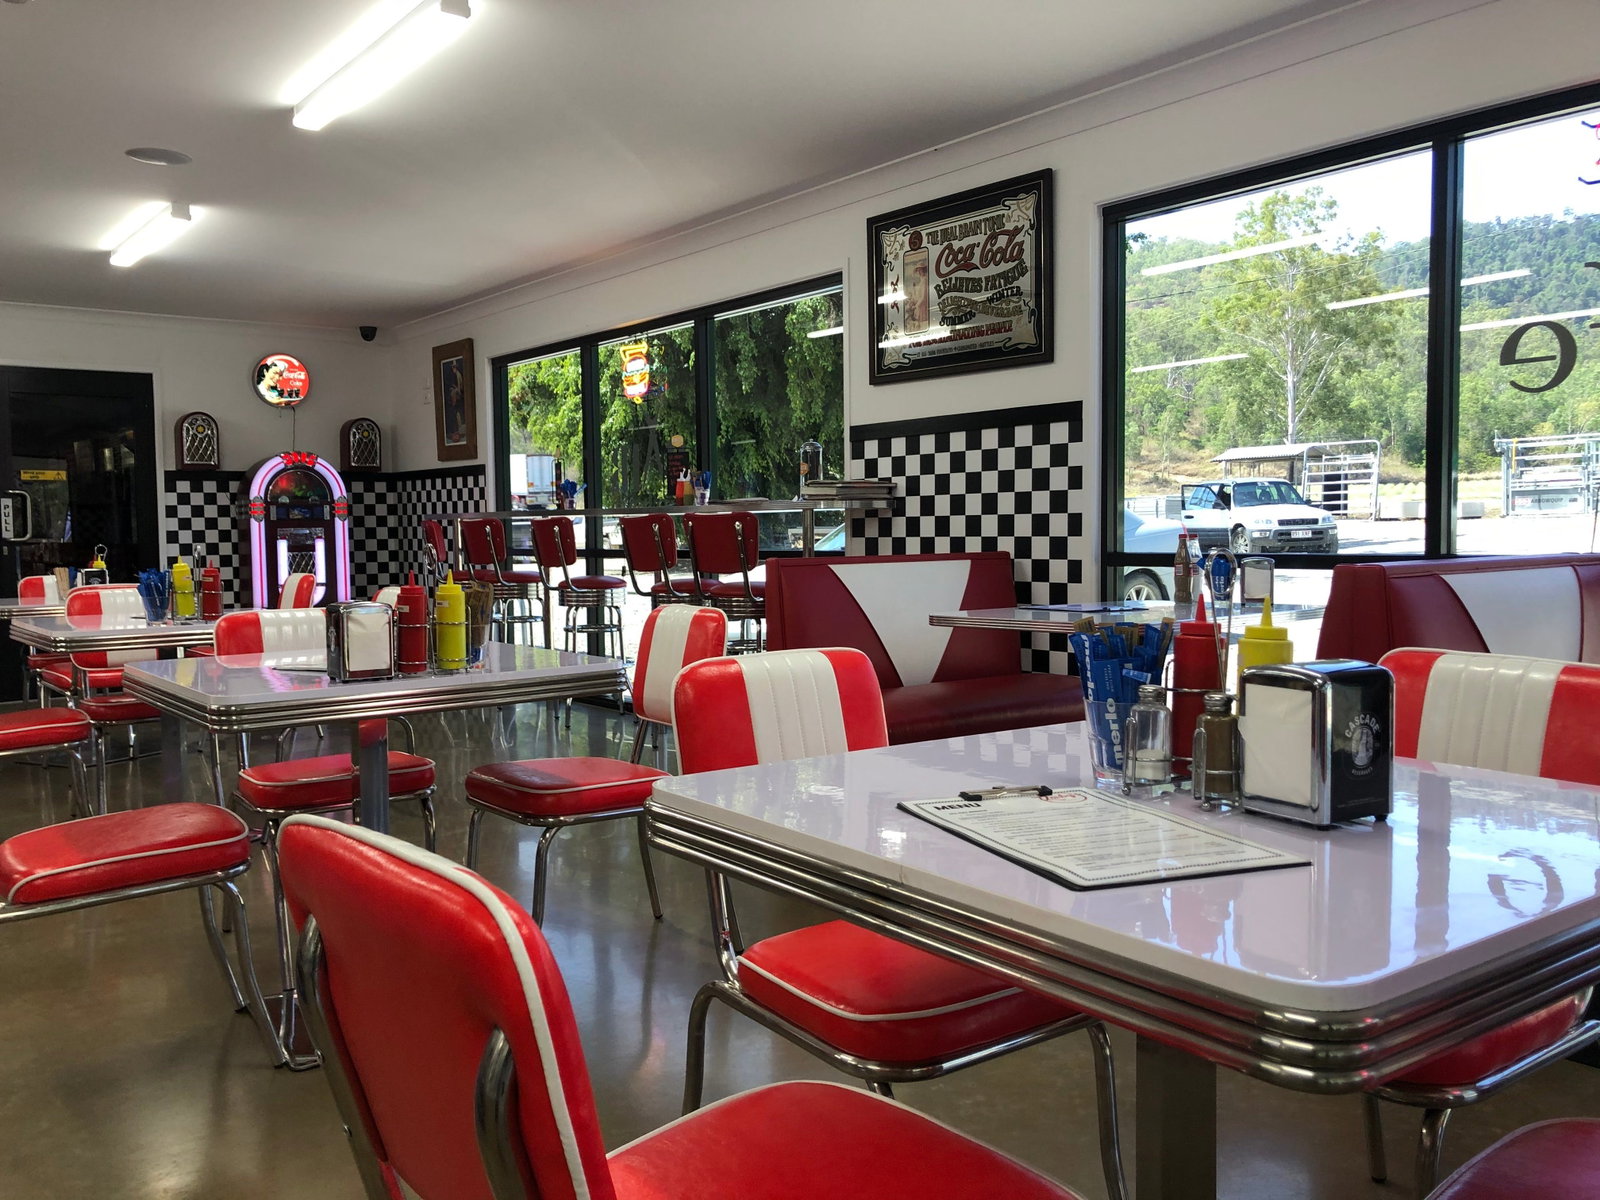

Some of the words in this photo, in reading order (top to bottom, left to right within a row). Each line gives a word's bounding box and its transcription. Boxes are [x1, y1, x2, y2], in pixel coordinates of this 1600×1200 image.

[925, 232, 940, 246] THE
[940, 226, 958, 246] IDEAL
[957, 218, 982, 242] BRAIN
[982, 213, 1006, 236] TONIC
[934, 276, 983, 299] RELIEVES
[939, 310, 976, 326] SUMMER
[1105, 697, 1124, 765] merlo
[1345, 714, 1379, 738] CASCADE
[934, 802, 982, 811] MENU
